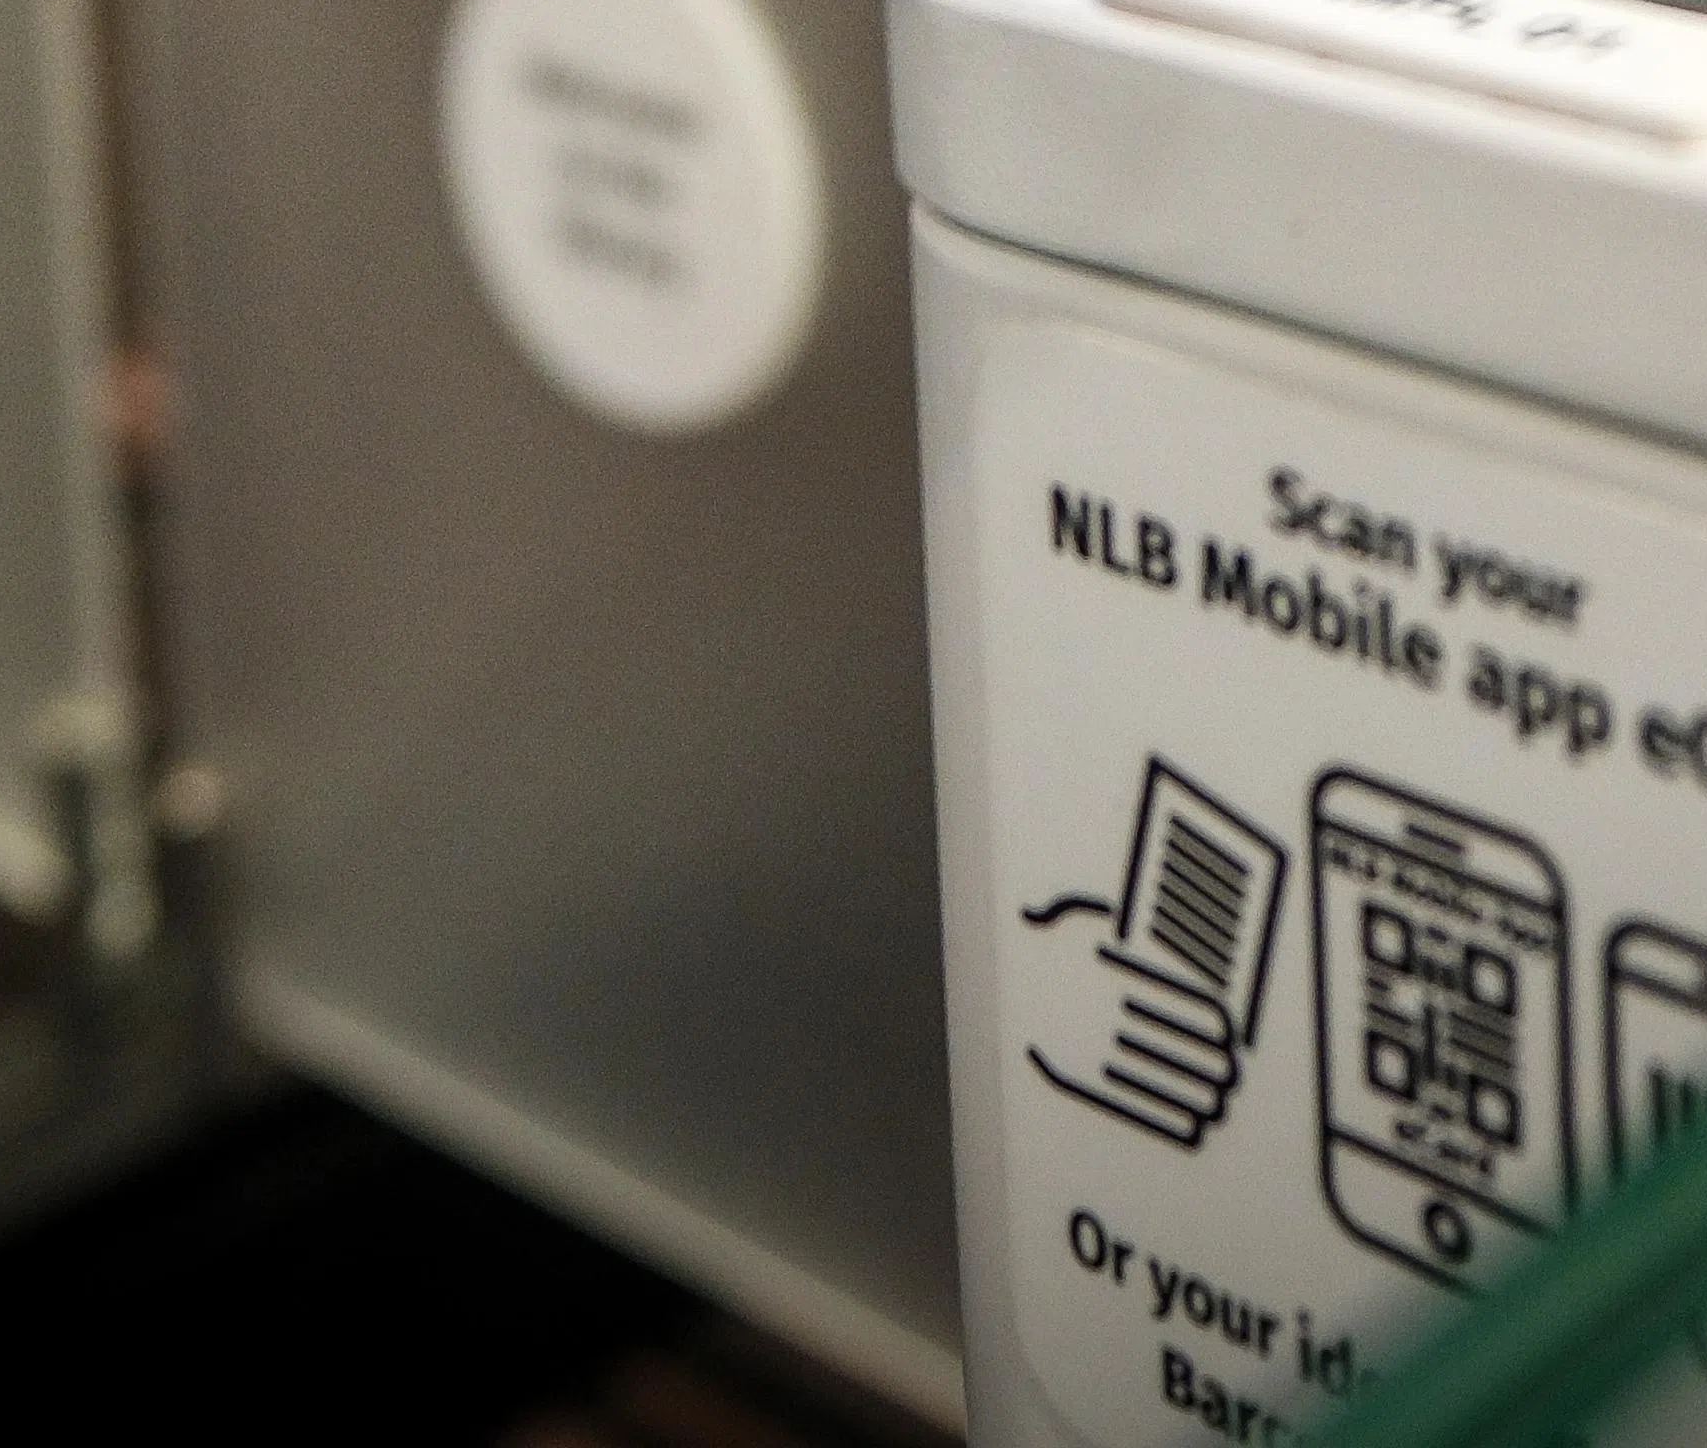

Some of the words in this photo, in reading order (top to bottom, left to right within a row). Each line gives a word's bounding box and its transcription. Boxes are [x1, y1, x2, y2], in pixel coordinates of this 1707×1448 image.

[1048, 481, 1180, 590] NLB
[1201, 535, 1444, 693] Mobile
[1467, 644, 1615, 767] app
[1266, 465, 1419, 572] Scan
[1434, 532, 1586, 632] your
[1068, 1206, 1135, 1284] Or
[1148, 1254, 1280, 1358] your
